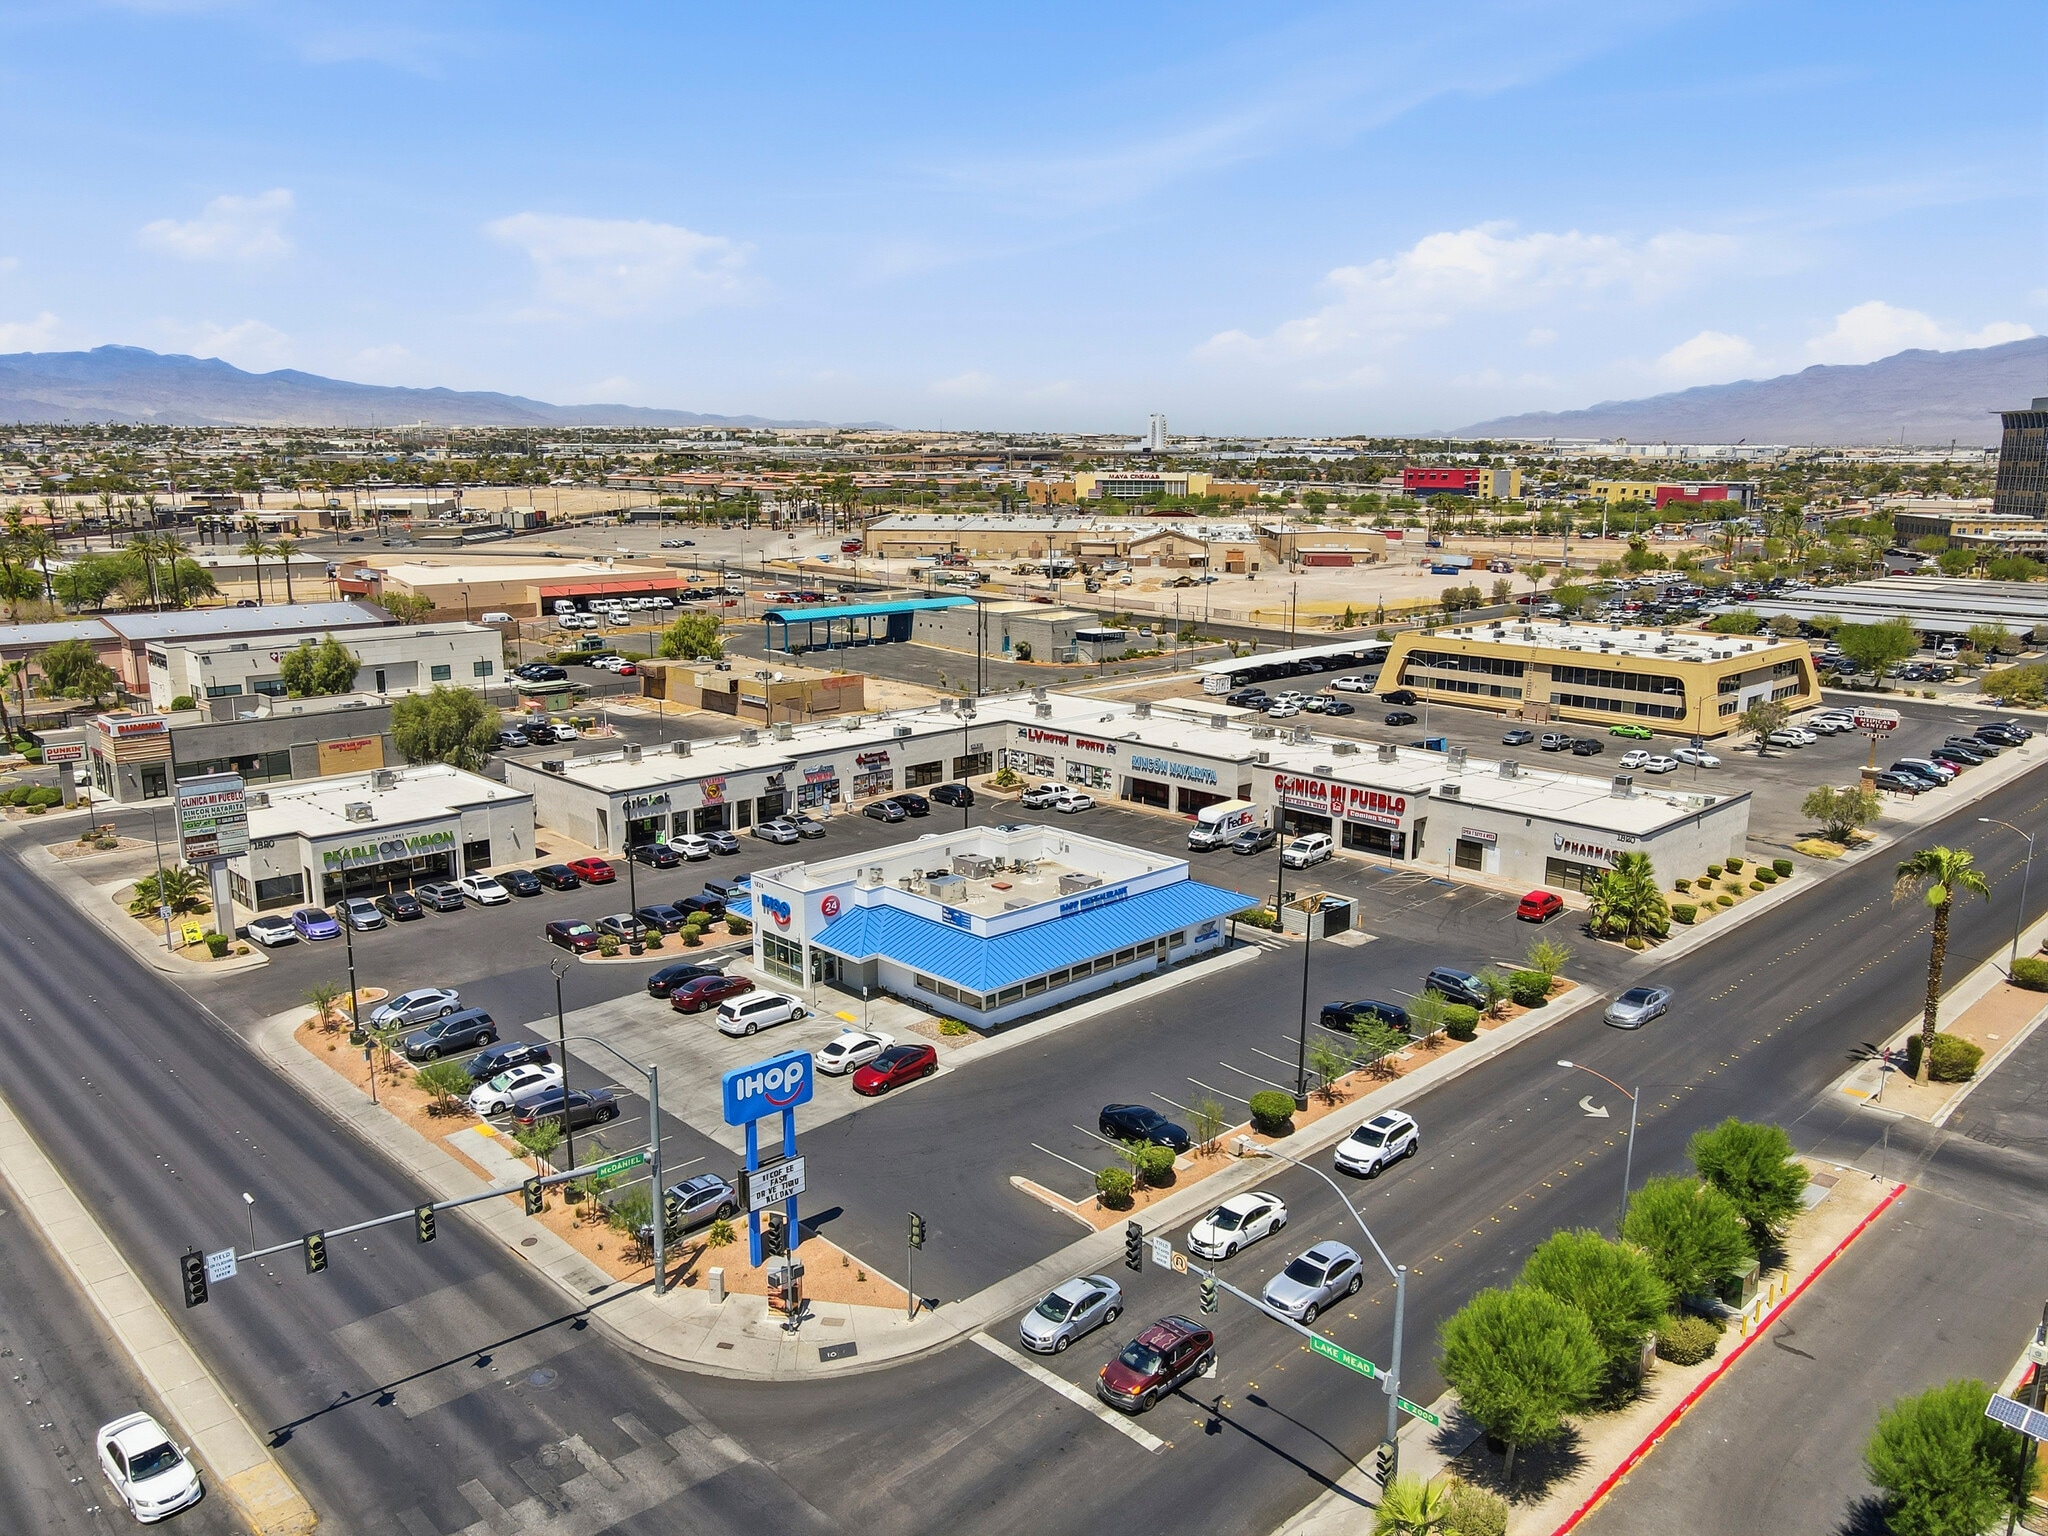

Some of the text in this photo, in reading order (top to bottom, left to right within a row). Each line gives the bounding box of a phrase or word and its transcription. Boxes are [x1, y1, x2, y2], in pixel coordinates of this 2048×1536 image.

[181, 790, 244, 808] CLINICA MI PUEBLO
[1330, 784, 1346, 801] MI
[1350, 788, 1406, 812] PUEBLO
[1228, 812, 1253, 830] FedEx
[1350, 810, 1376, 820] Coming
[404, 831, 454, 849] VISION
[826, 901, 836, 912] 24
[736, 1061, 804, 1100] IHOP
[600, 1156, 640, 1175] McDANIEL
[212, 1252, 230, 1261] YIELD
[1314, 1340, 1370, 1374] LAKE MEAD
[1404, 1401, 1434, 1422] E 2000
